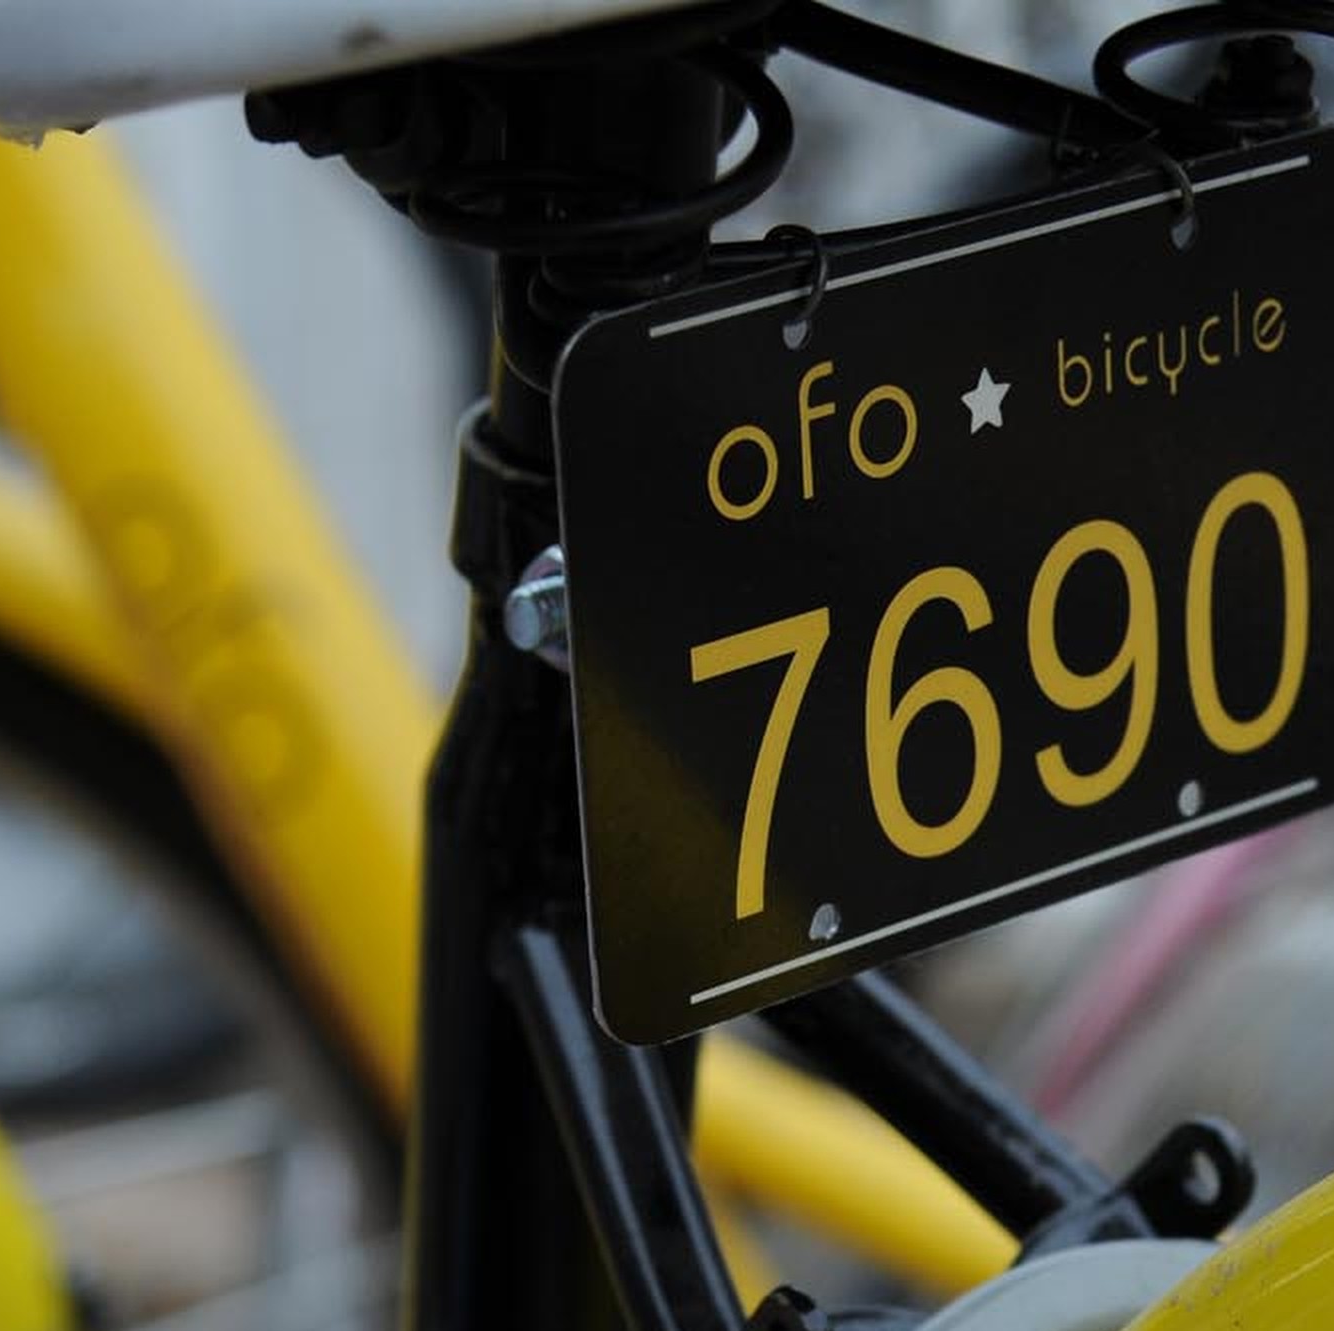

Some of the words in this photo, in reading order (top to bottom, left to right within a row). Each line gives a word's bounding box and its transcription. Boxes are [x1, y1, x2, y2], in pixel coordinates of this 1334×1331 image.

[707, 360, 918, 521] ofo
[1056, 289, 1287, 407] bicycle
[690, 471, 1311, 920] 7690
